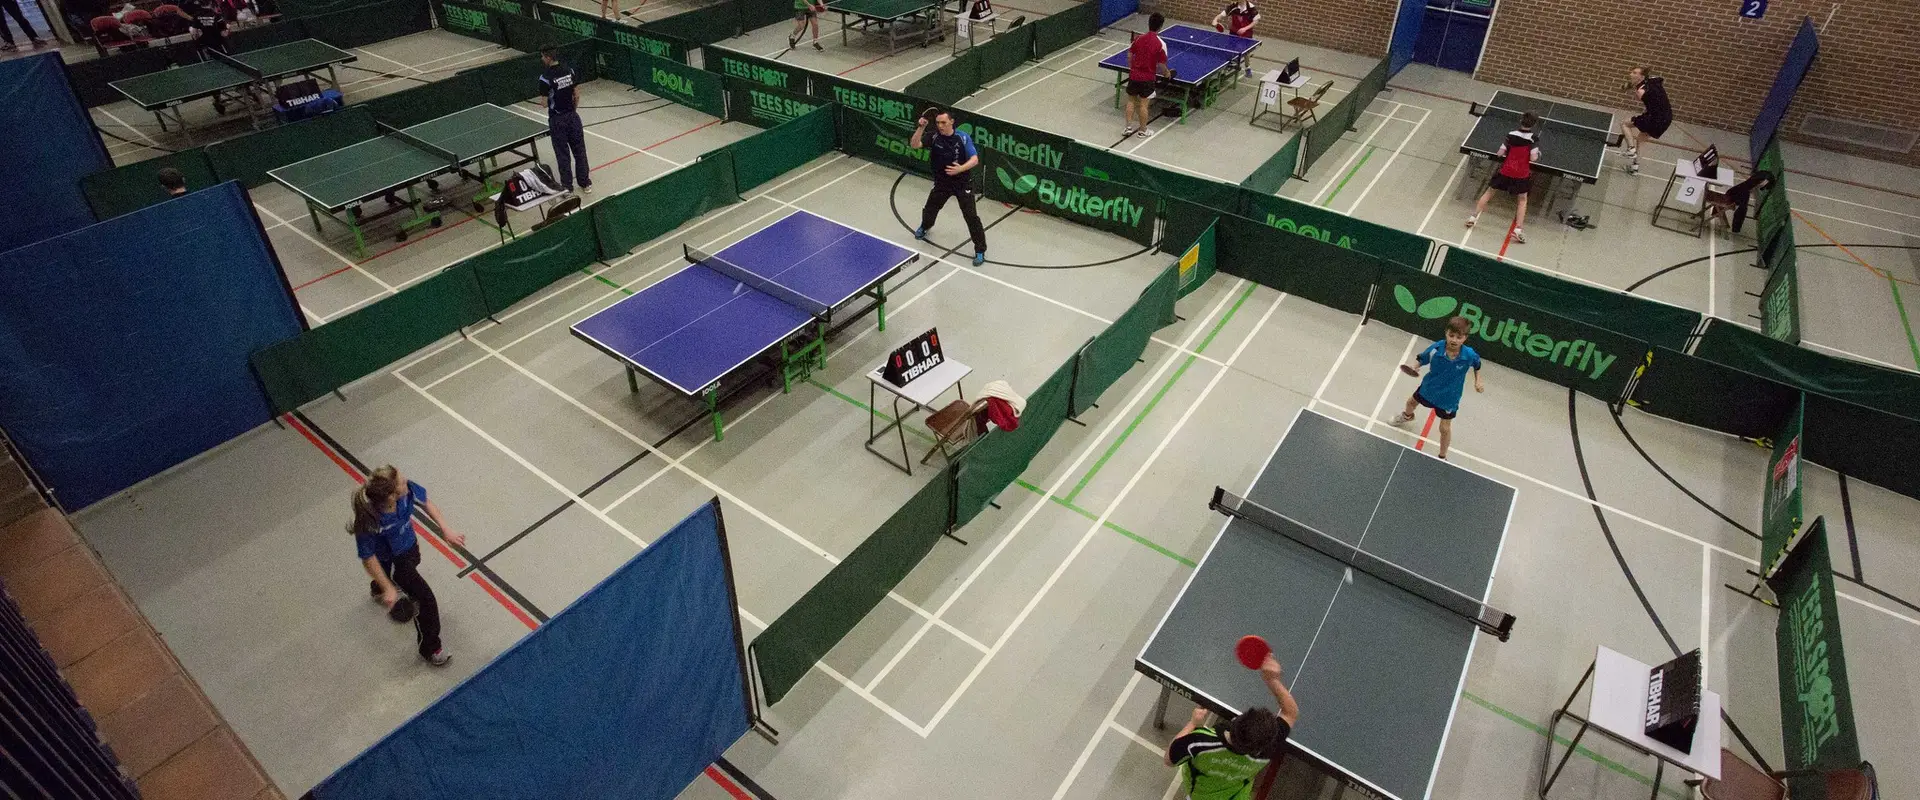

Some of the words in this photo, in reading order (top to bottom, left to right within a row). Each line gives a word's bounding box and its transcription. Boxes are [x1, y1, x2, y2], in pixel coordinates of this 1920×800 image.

[1745, 0, 1760, 16] 2
[613, 30, 639, 50] TEES
[639, 36, 671, 56] SPORT
[652, 67, 695, 97] JOOLA
[722, 57, 750, 78] TEES
[751, 64, 788, 88] SPORT
[286, 93, 320, 107] TIBHAR
[750, 90, 783, 113] TEES
[783, 98, 818, 117] SPO
[832, 86, 867, 108] TEES
[868, 95, 914, 120] SPORT
[1264, 88, 1276, 99] 10
[876, 134, 931, 162] DONI
[974, 126, 1063, 170] Butterfly
[516, 190, 541, 204] TIBH
[519, 180, 528, 194] 0
[1684, 186, 1695, 197] 9
[1037, 178, 1143, 228] Butterfly
[905, 350, 914, 367] 0
[921, 340, 931, 357] 0
[1457, 302, 1618, 380] Butterfly
[901, 353, 941, 382] TIBHAR
[702, 381, 721, 397] JOOLA
[1800, 571, 1824, 651] TEES
[1154, 674, 1193, 700] TIBHAR
[1645, 668, 1664, 728] TIBHAR
[1802, 640, 1840, 748] SPORT
